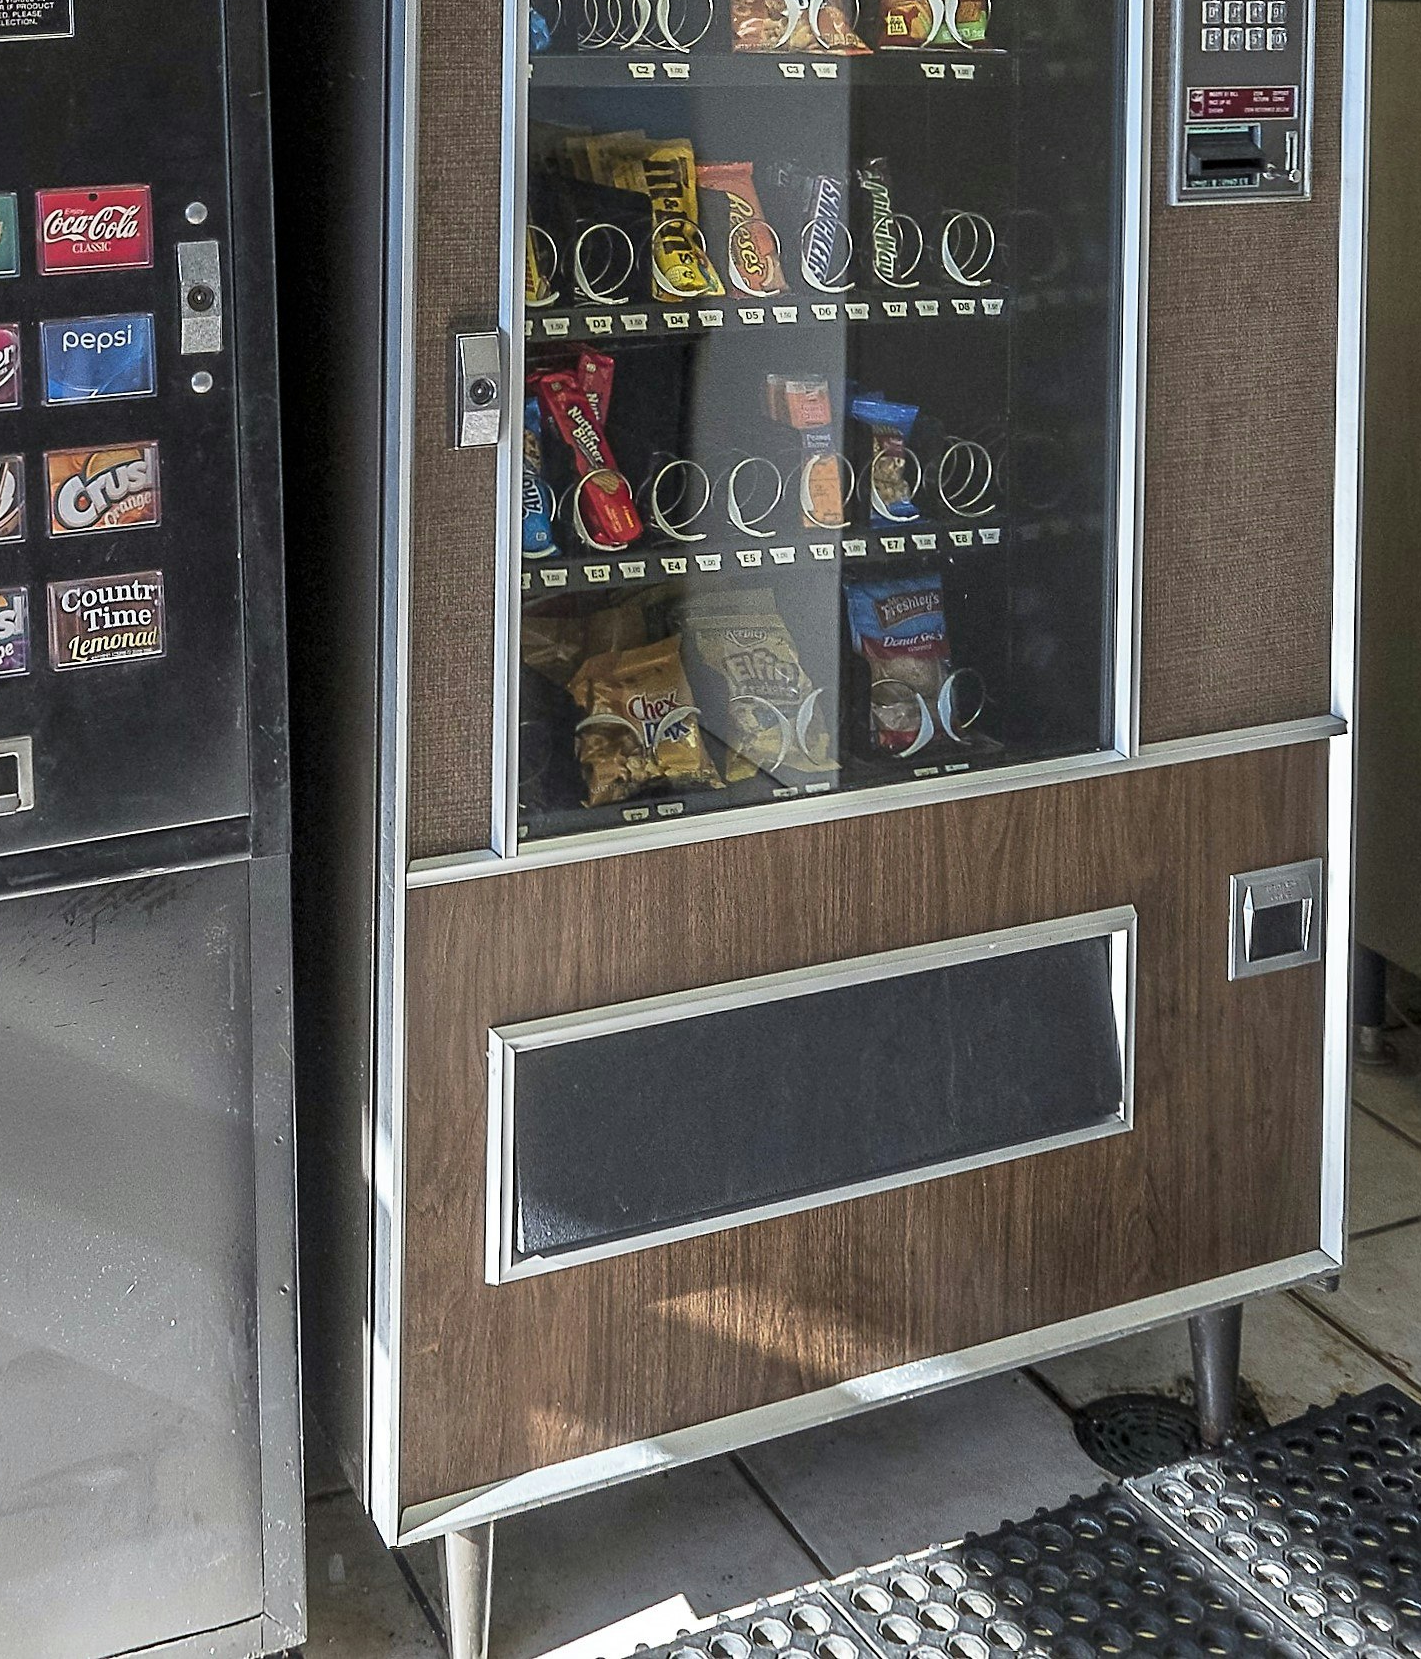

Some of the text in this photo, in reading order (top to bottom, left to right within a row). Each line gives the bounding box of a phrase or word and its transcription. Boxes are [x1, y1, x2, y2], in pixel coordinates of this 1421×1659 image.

[6, 3, 14, 11] IF
[16, 2, 54, 10] PRODUCT
[12, 10, 42, 18] PLEASE
[636, 66, 649, 74] C2
[786, 66, 799, 74] C3
[928, 66, 940, 74] C4
[44, 205, 142, 243] Coca-Cola
[72, 242, 112, 254] CLASSIC
[593, 319, 606, 328] D3
[670, 316, 683, 324] D4
[745, 311, 759, 320] D5
[819, 308, 832, 316] D6
[889, 304, 901, 312] D7
[958, 302, 970, 310] D8
[62, 324, 133, 354] pepsi
[567, 405, 601, 442] Nutter
[572, 427, 605, 463] Butter
[104, 491, 152, 527] Orange
[591, 569, 605, 579] E3
[668, 561, 681, 570] E4
[743, 554, 756, 563] E5
[816, 548, 829, 556] E6
[887, 540, 899, 549] E7
[955, 534, 968, 543] E8
[83, 606, 152, 632] Time
[881, 592, 940, 620] Freshley's
[883, 635, 919, 648] Donut
[626, 689, 677, 721] Chex
